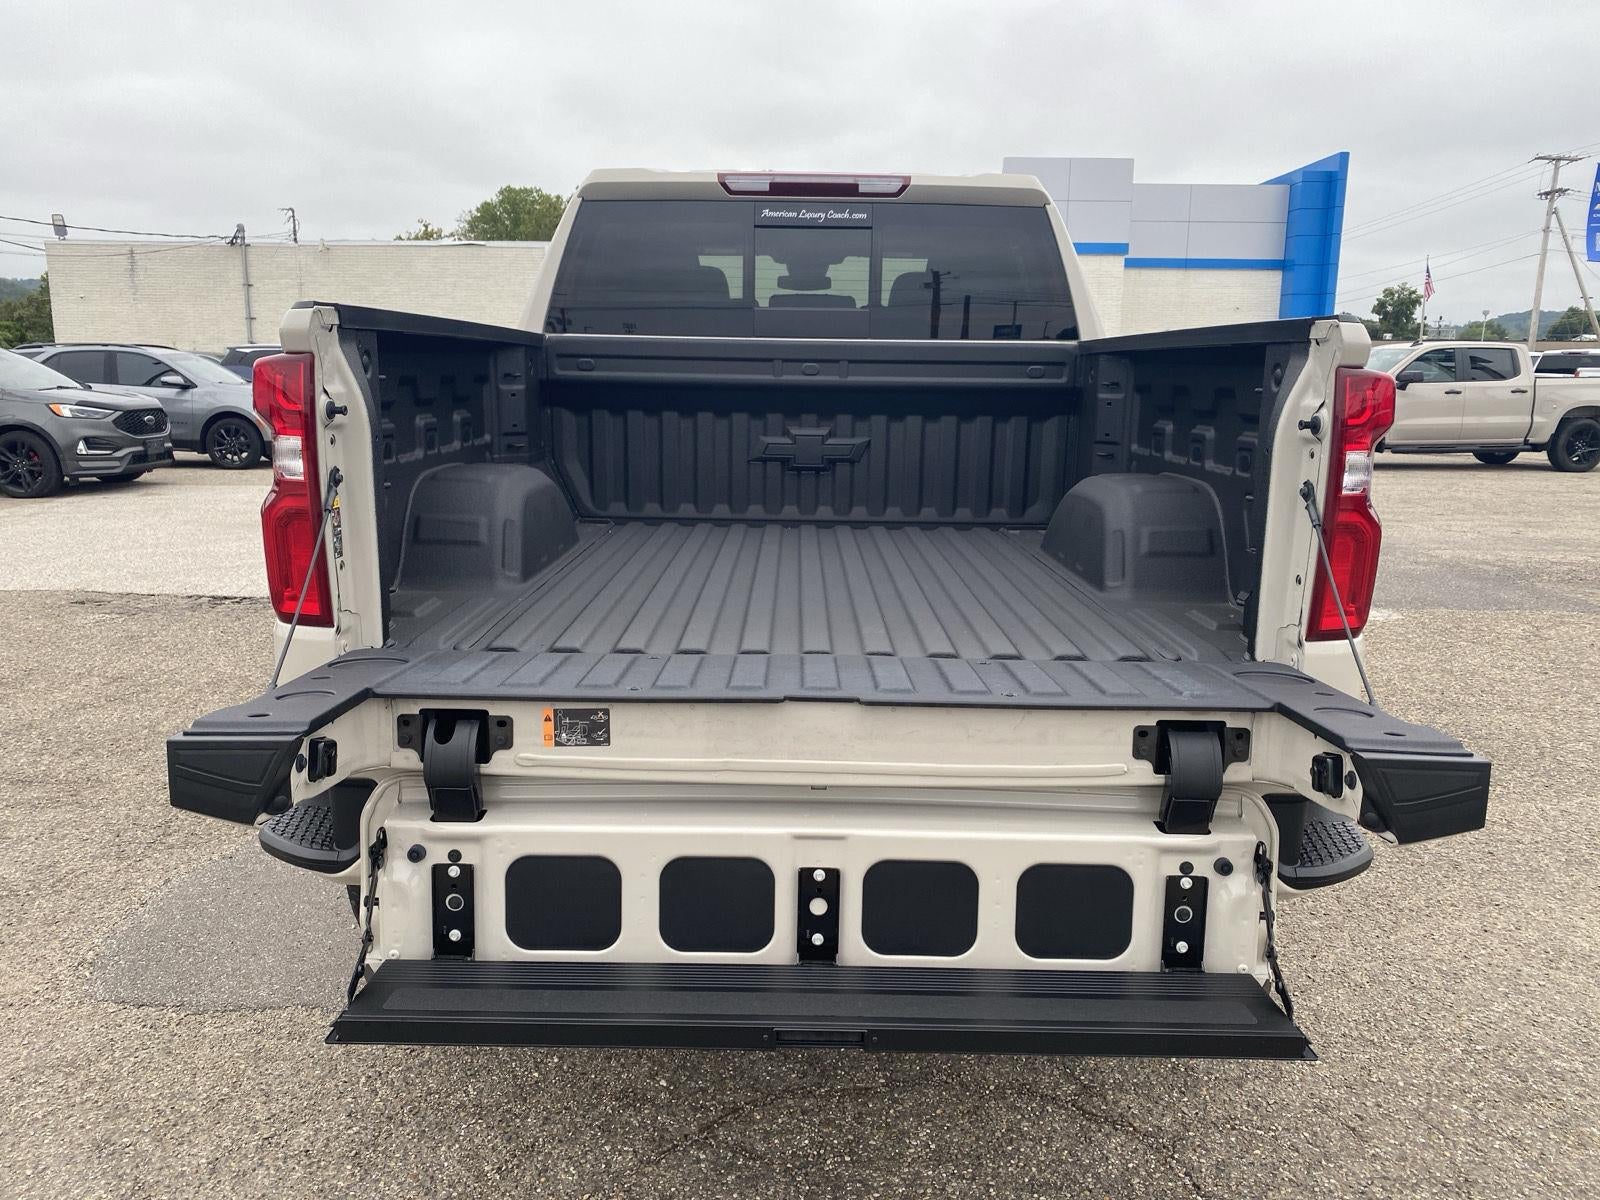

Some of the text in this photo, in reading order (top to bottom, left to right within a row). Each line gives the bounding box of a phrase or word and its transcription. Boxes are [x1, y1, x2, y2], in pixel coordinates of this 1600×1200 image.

[761, 208, 867, 223] American Luxury Coach.com
